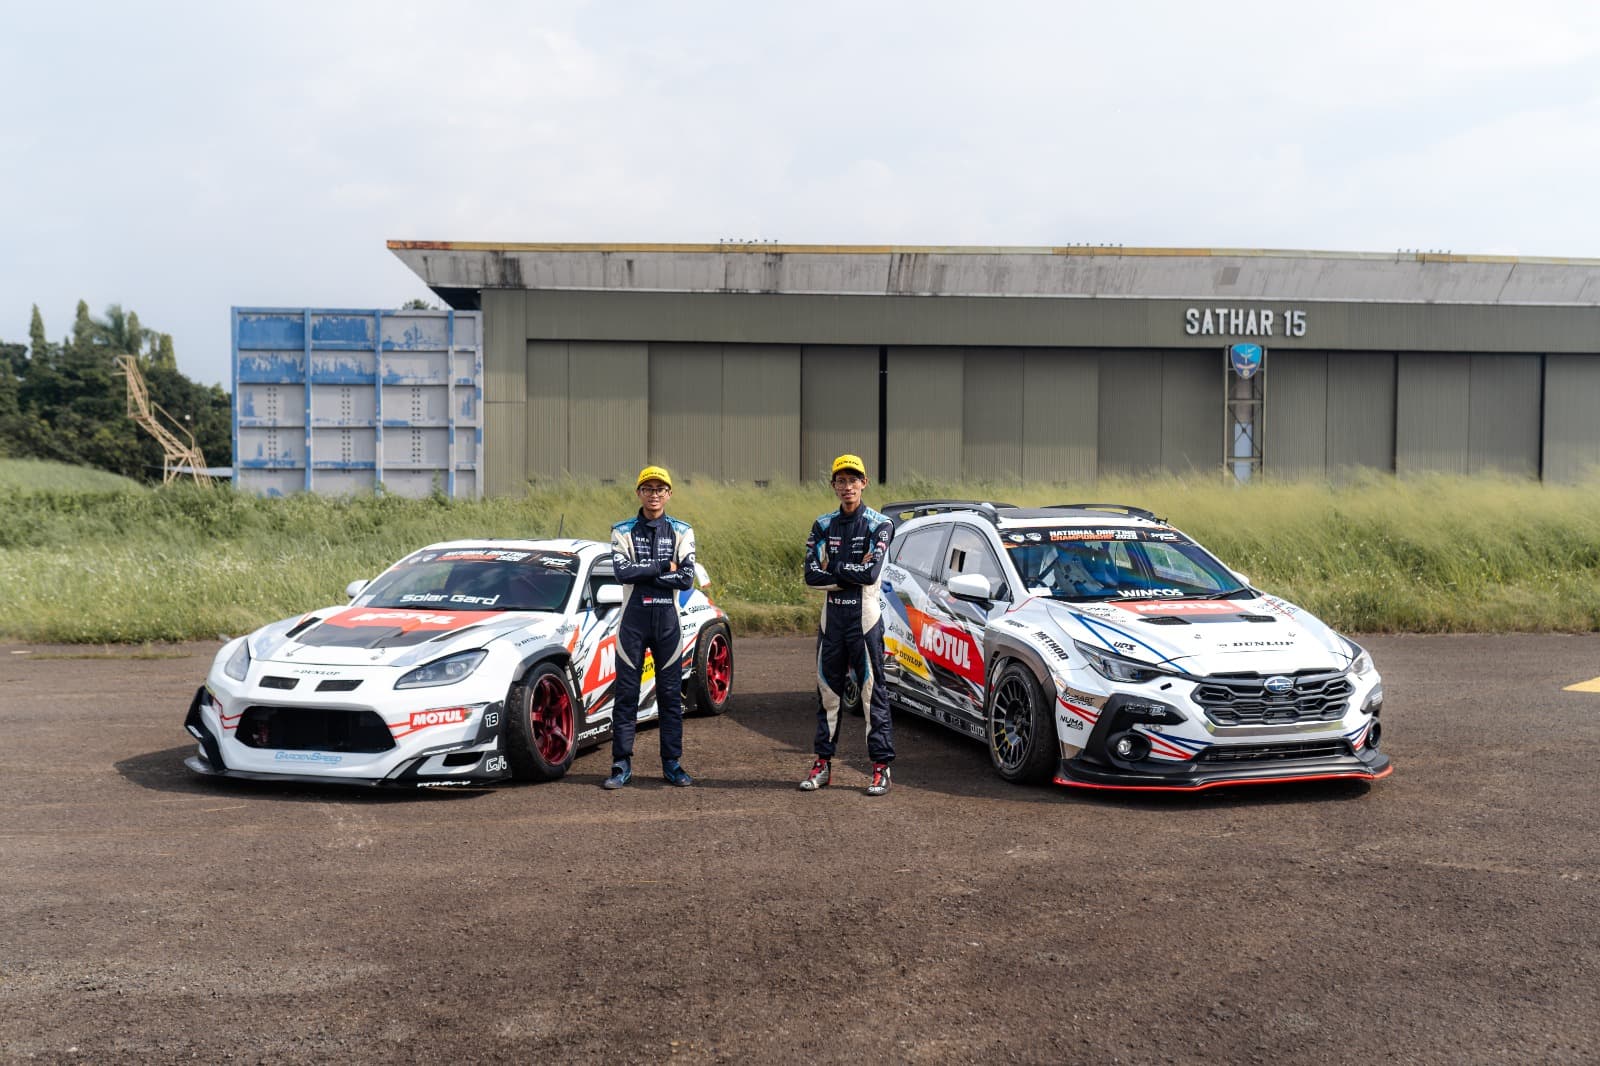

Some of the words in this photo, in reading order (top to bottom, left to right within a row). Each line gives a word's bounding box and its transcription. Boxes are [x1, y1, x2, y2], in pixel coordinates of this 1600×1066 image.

[1186, 308, 1274, 336] SATHAR
[1284, 310, 1306, 336] 15
[400, 593, 448, 602] Solar
[449, 594, 501, 605] Gard
[1117, 588, 1184, 597] WINCOS
[1135, 602, 1233, 612] MOTUL
[919, 623, 971, 670] MOTUL
[1036, 631, 1070, 661] METHOD
[899, 649, 923, 668] DUNLOP
[412, 710, 463, 726] MOTUL
[1059, 714, 1084, 728] NUMA
